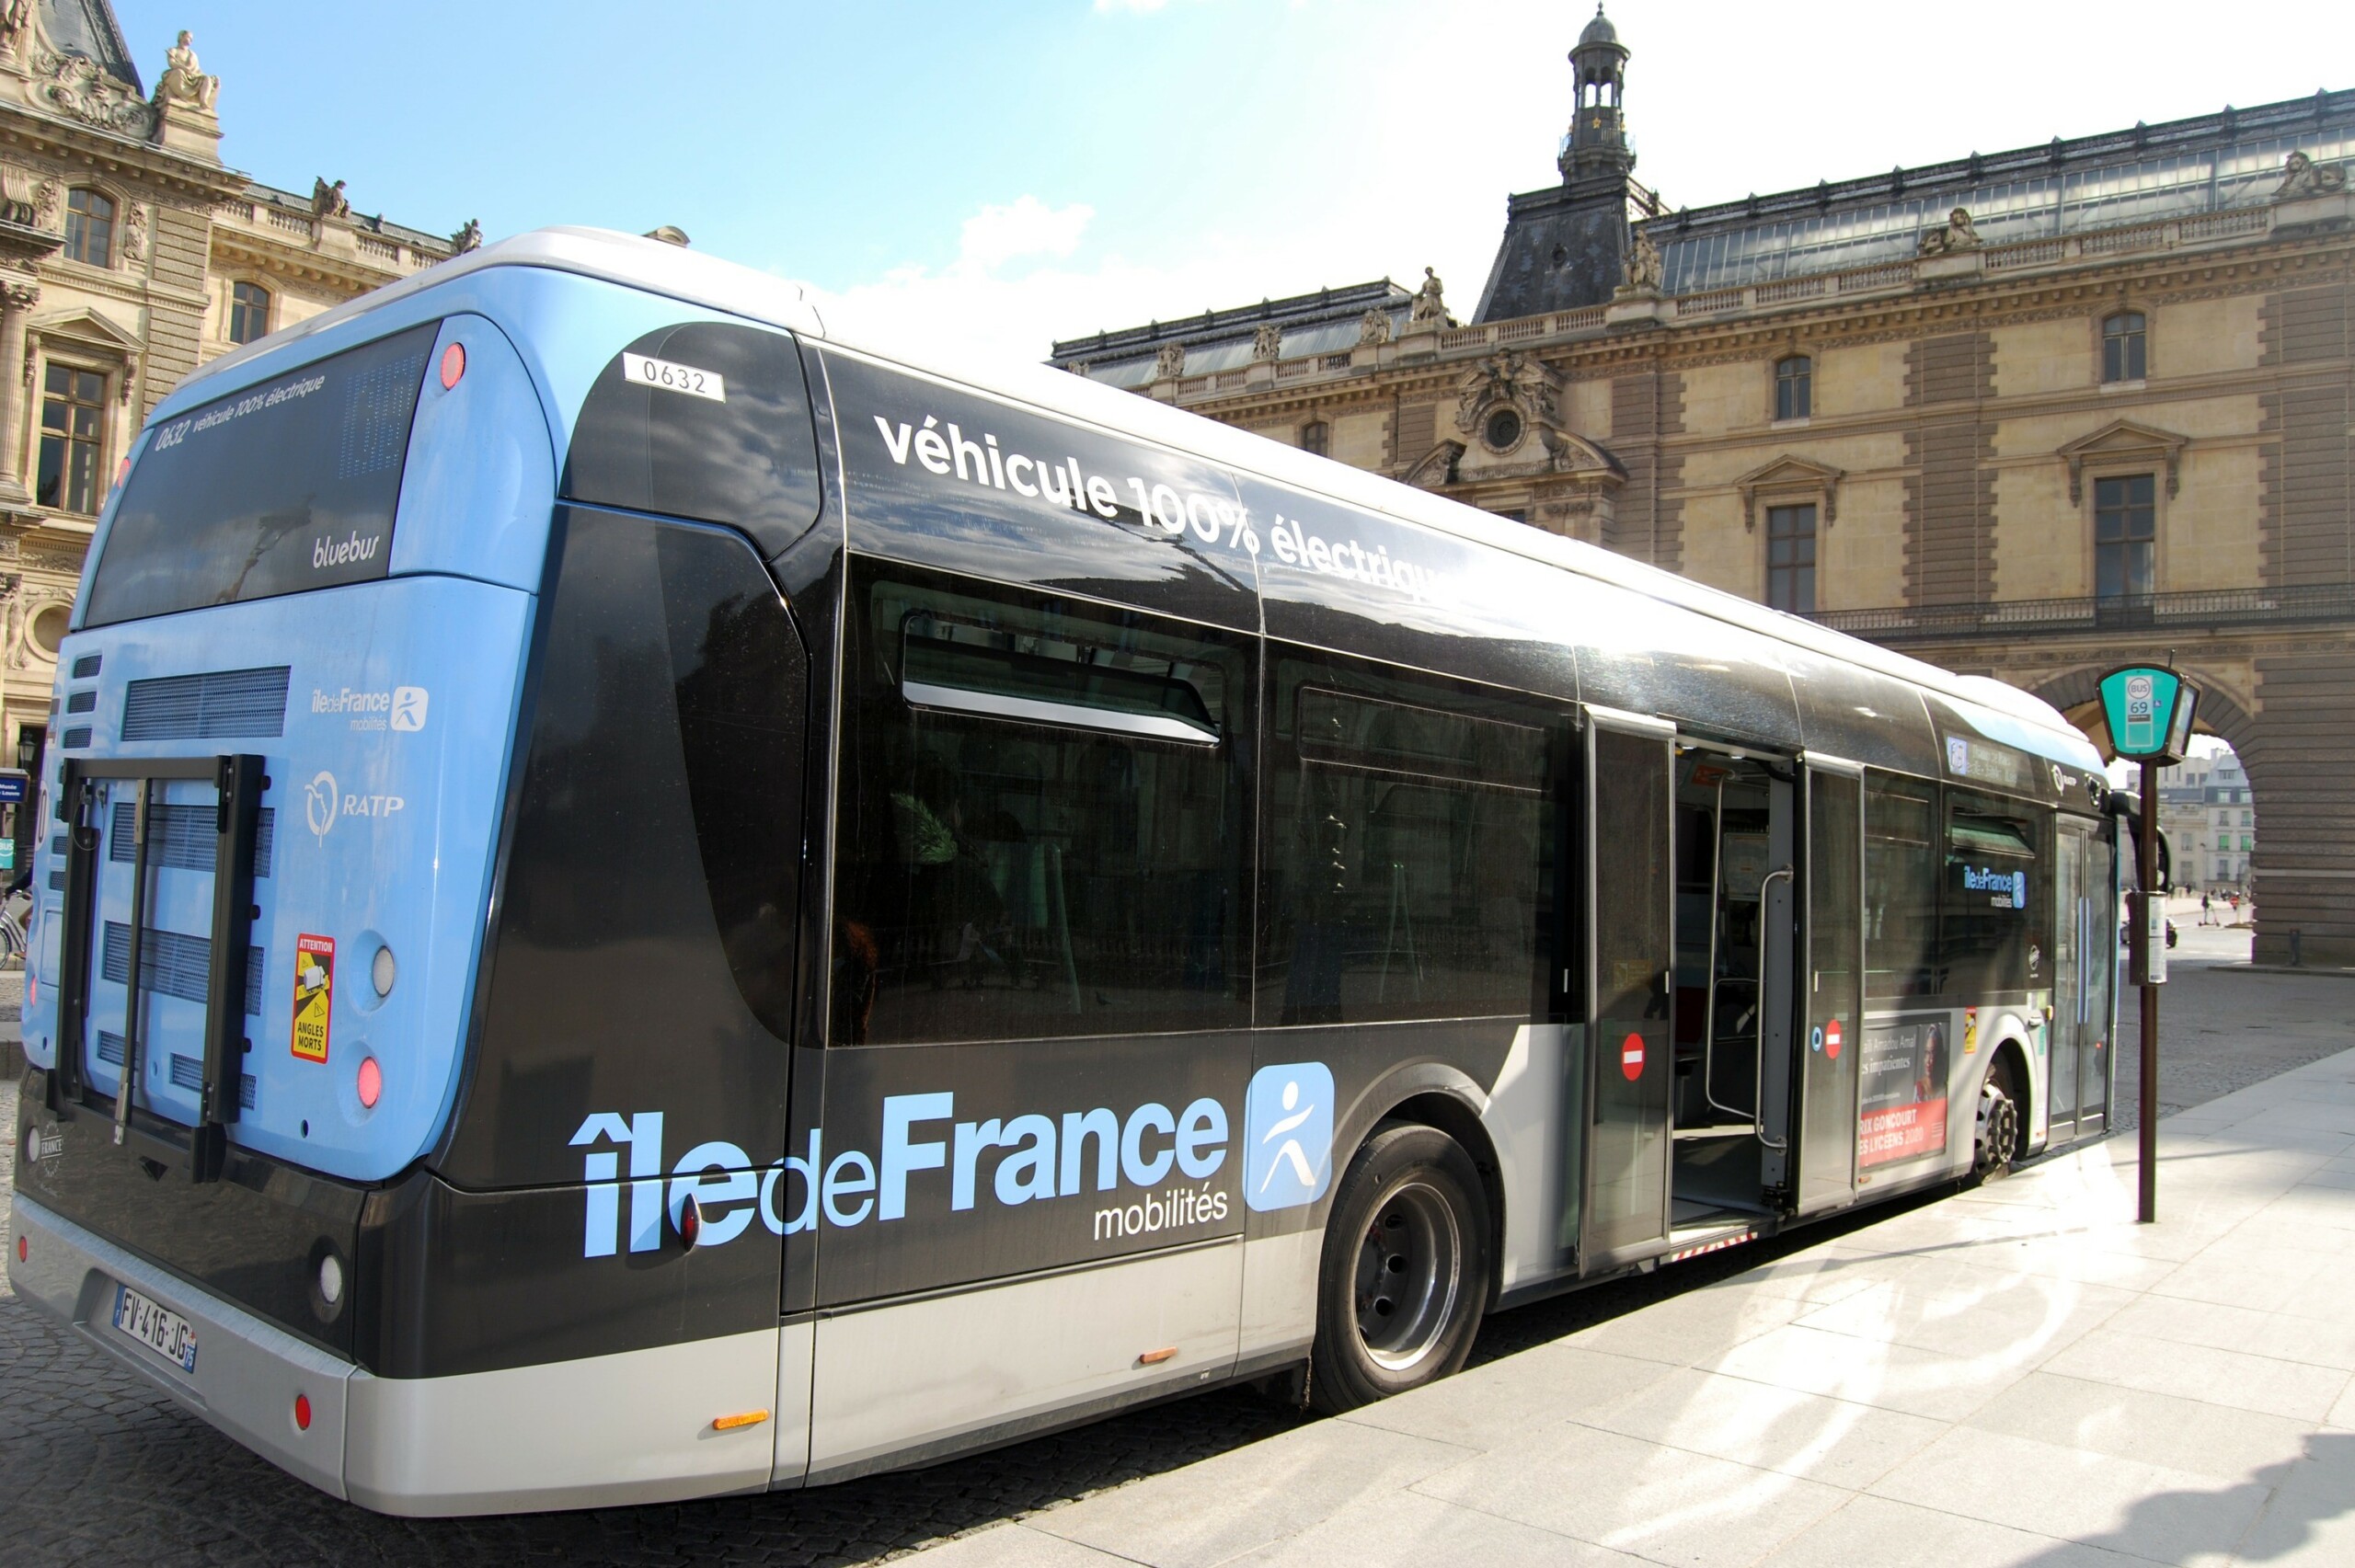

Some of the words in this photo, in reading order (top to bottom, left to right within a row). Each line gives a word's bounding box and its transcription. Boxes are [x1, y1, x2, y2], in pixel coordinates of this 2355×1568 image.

[644, 361, 706, 394] 0632
[155, 418, 191, 452] 0632
[193, 406, 235, 433] véhicule
[234, 393, 267, 418] 100%
[265, 374, 326, 407] électrique
[874, 415, 1117, 518] véhicule
[1128, 477, 1261, 555] 100%
[1270, 513, 1453, 602] électriqu
[312, 530, 380, 569] bluebus
[2131, 684, 2148, 693] BUS
[2131, 701, 2148, 714] 69
[350, 715, 387, 731] mobilités
[342, 794, 405, 818] RATP
[299, 938, 333, 953] ATTENTION
[297, 1021, 324, 1038] ANGLES
[298, 1035, 322, 1051] MORTS
[1860, 1118, 1873, 1135] RIX
[1873, 1108, 1917, 1132] GONCOURT
[1858, 1139, 1869, 1156] ES
[1094, 1182, 1229, 1242] mobilités
